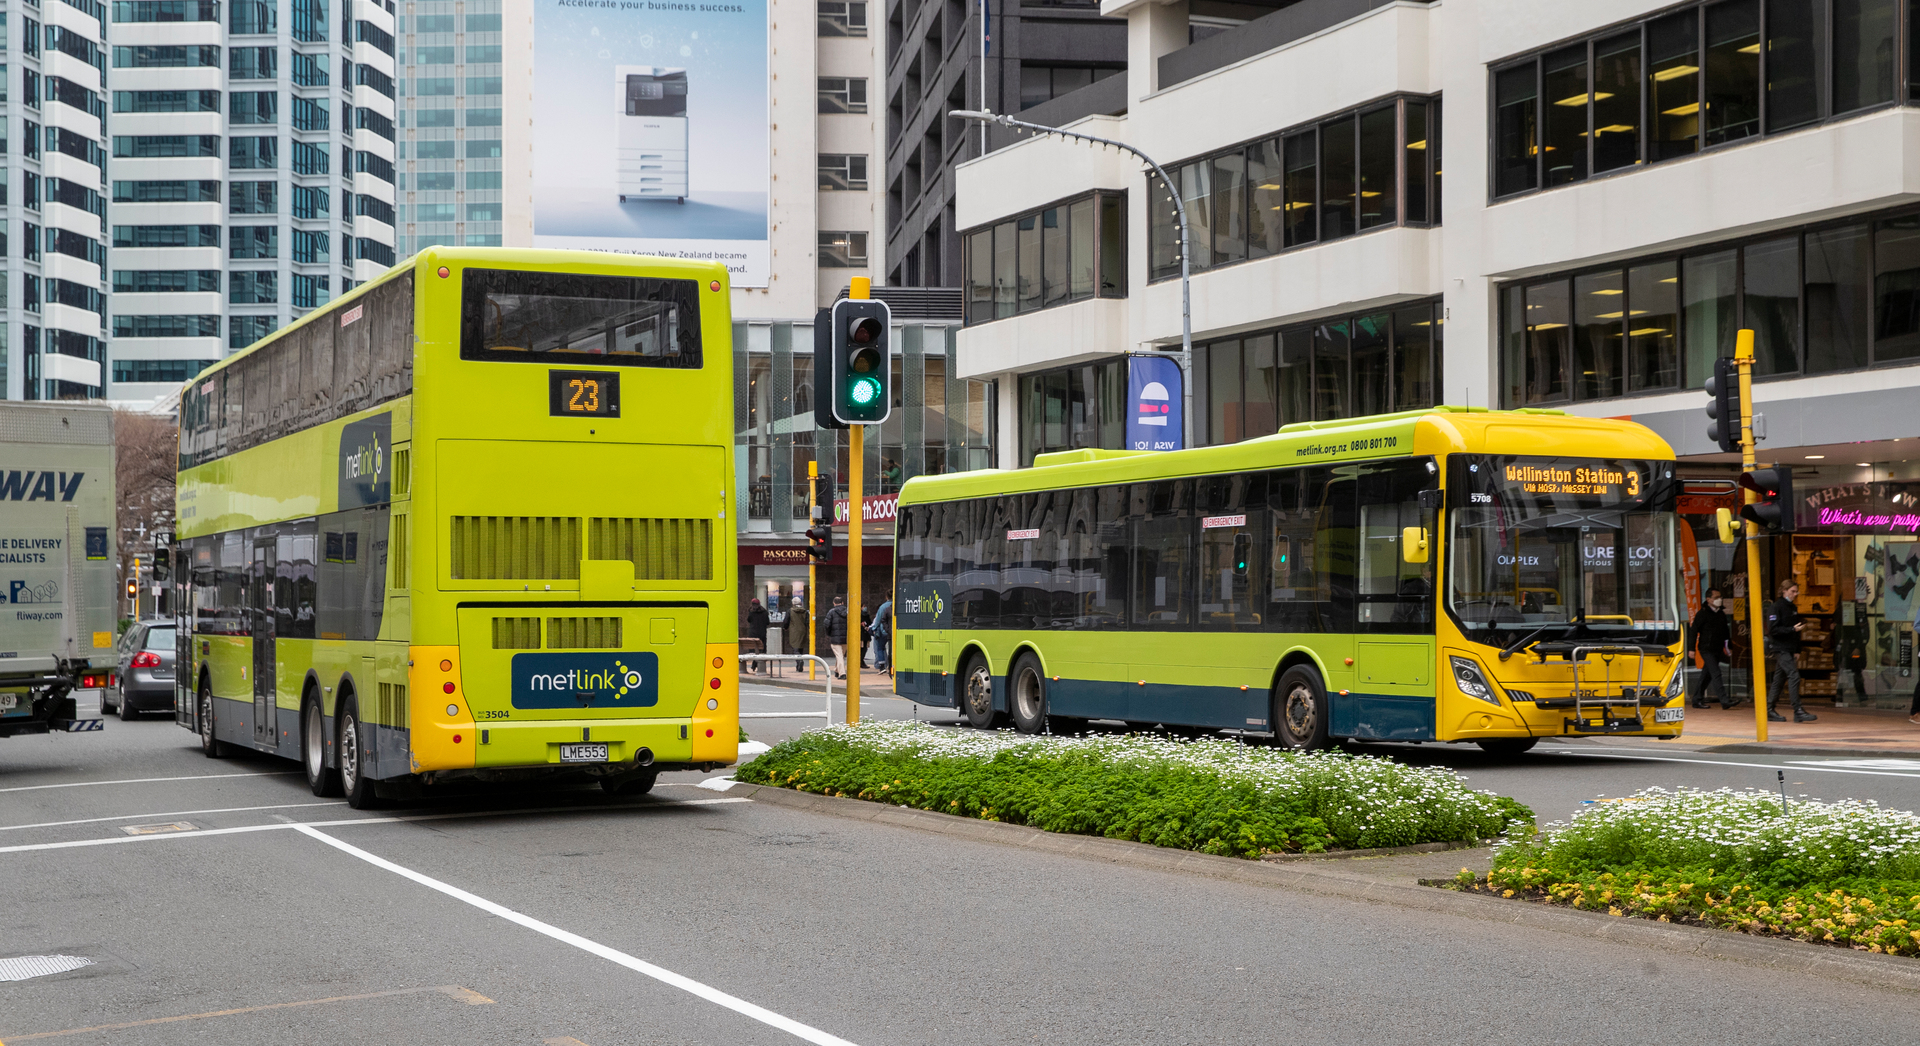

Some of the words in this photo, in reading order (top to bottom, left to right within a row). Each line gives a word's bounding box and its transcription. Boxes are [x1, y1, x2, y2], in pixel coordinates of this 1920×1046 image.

[558, 0, 616, 8] Accelerate
[620, 2, 644, 11] your
[648, 1, 696, 11] business
[699, 4, 746, 13] success.
[658, 250, 677, 258] New
[678, 250, 712, 259] Zealand
[714, 251, 747, 260] became
[569, 379, 599, 412] 23
[1296, 443, 1347, 457] metlink.org.nz
[1350, 439, 1368, 451] 0800
[1369, 437, 1383, 449] 801
[1384, 436, 1397, 448] 700
[345, 443, 374, 480] metlink
[1506, 465, 1572, 483] Wellington
[1576, 467, 1623, 484] Station
[1523, 483, 1537, 493] VIA
[1561, 484, 1591, 494] MASSEY
[1593, 485, 1607, 494] UNI
[1627, 471, 1640, 496] 3
[1470, 495, 1492, 503] 5708
[1878, 485, 1918, 508] NW
[842, 500, 872, 522] Hth
[1820, 507, 1862, 525] What's
[1863, 514, 1890, 526] new
[11, 538, 62, 549] DELIVERY
[763, 549, 807, 558] PASCOES
[1497, 555, 1539, 566] OLAPLEX
[905, 595, 935, 613] metlink
[16, 610, 63, 622] fliway.com
[531, 669, 616, 690] metlink
[485, 710, 510, 719] 3504
[1656, 708, 1684, 720] NQY743
[562, 746, 607, 759] LME553
